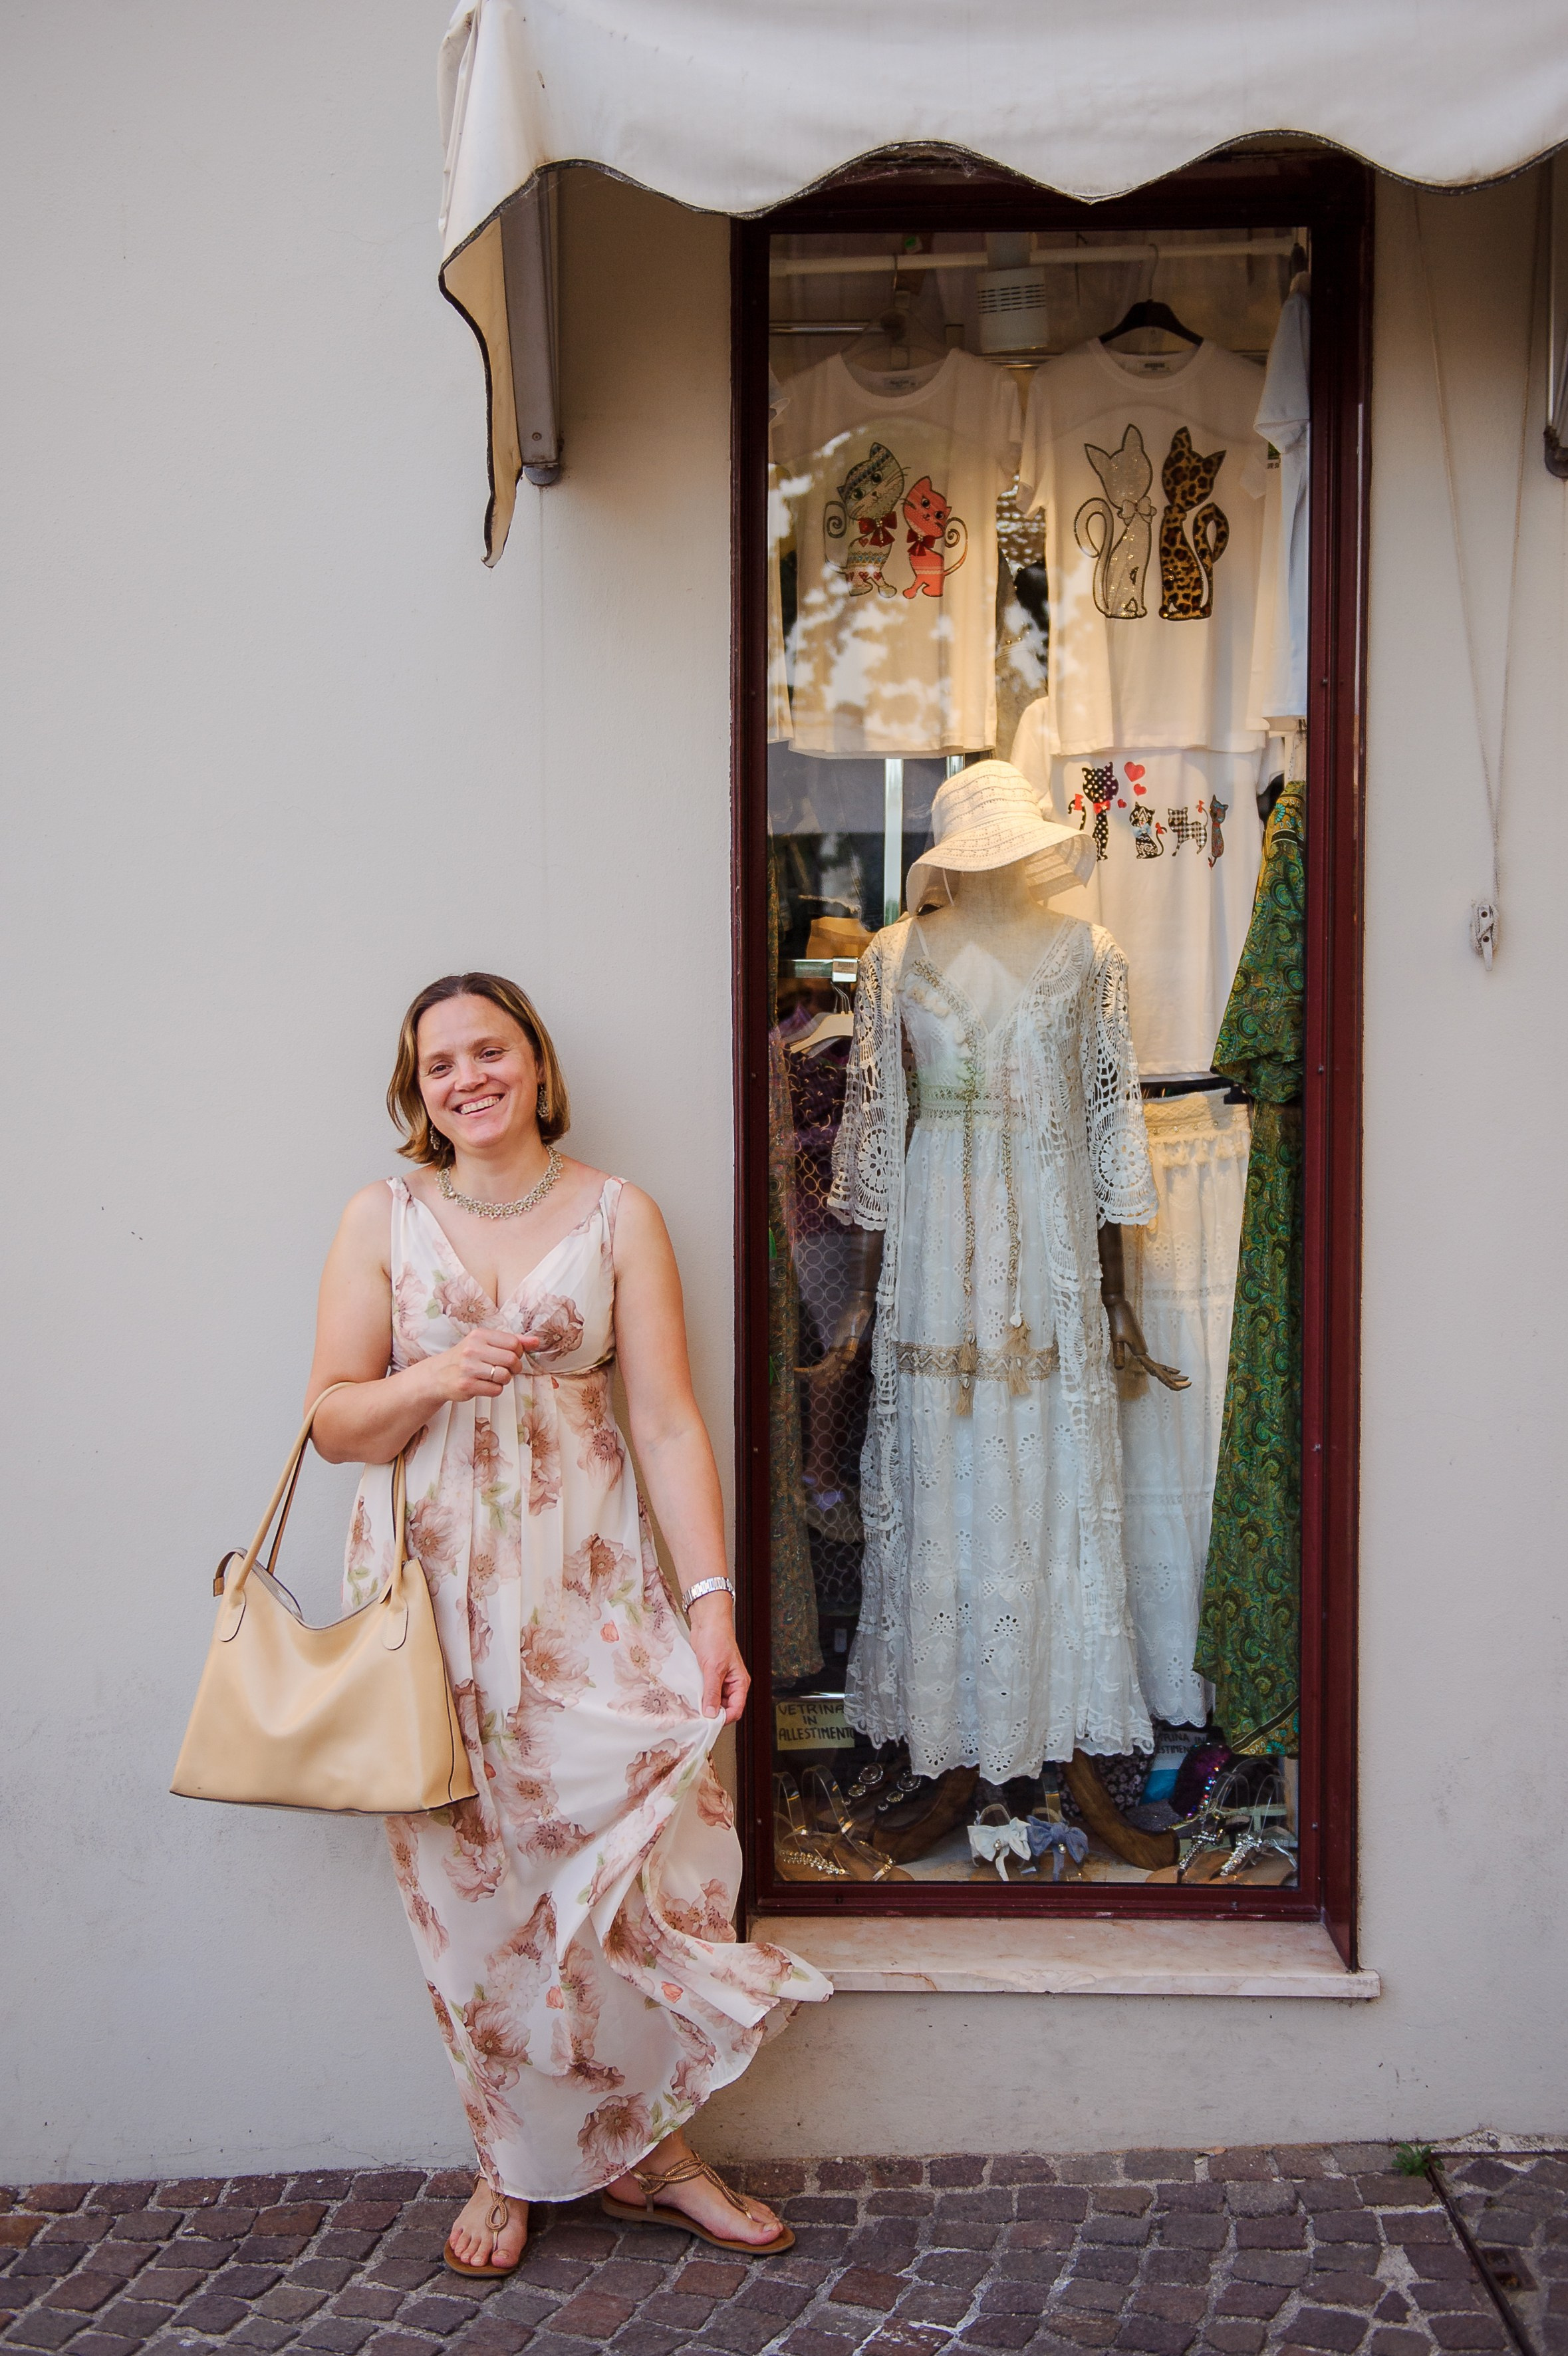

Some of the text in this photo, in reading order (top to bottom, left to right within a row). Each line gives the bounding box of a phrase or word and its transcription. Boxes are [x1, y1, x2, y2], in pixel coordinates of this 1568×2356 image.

[779, 1704, 844, 1715] VETRINA
[803, 1715, 817, 1725] IN
[779, 1727, 855, 1741] ALLESTIMENTO
